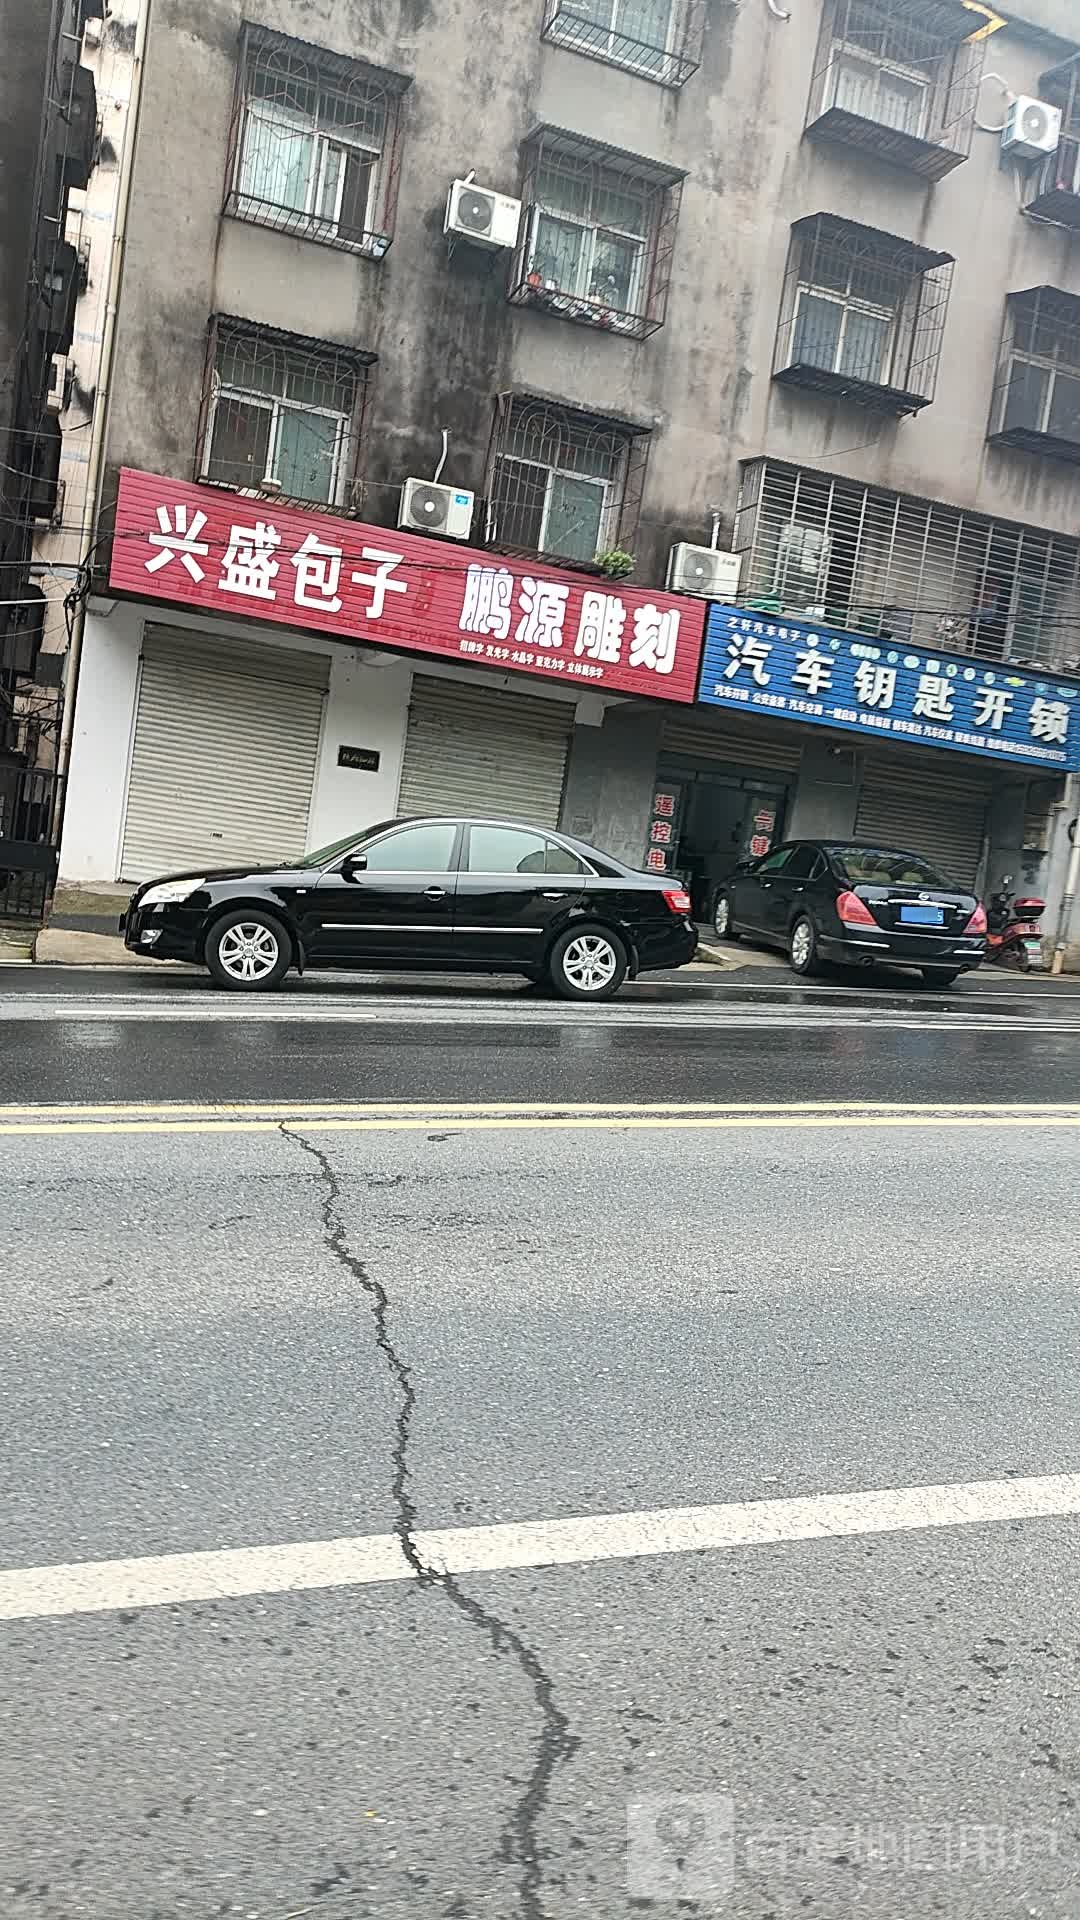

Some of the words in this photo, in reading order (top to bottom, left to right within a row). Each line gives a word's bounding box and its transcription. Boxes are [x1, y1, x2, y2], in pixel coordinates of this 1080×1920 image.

[144, 504, 409, 620] 兴盛包子
[458, 563, 681, 675] 鹏源雕刻
[511, 650, 535, 665] 水晶字
[535, 655, 566, 671] 亚克力字
[723, 632, 1073, 744] 汽车钥匙开锁
